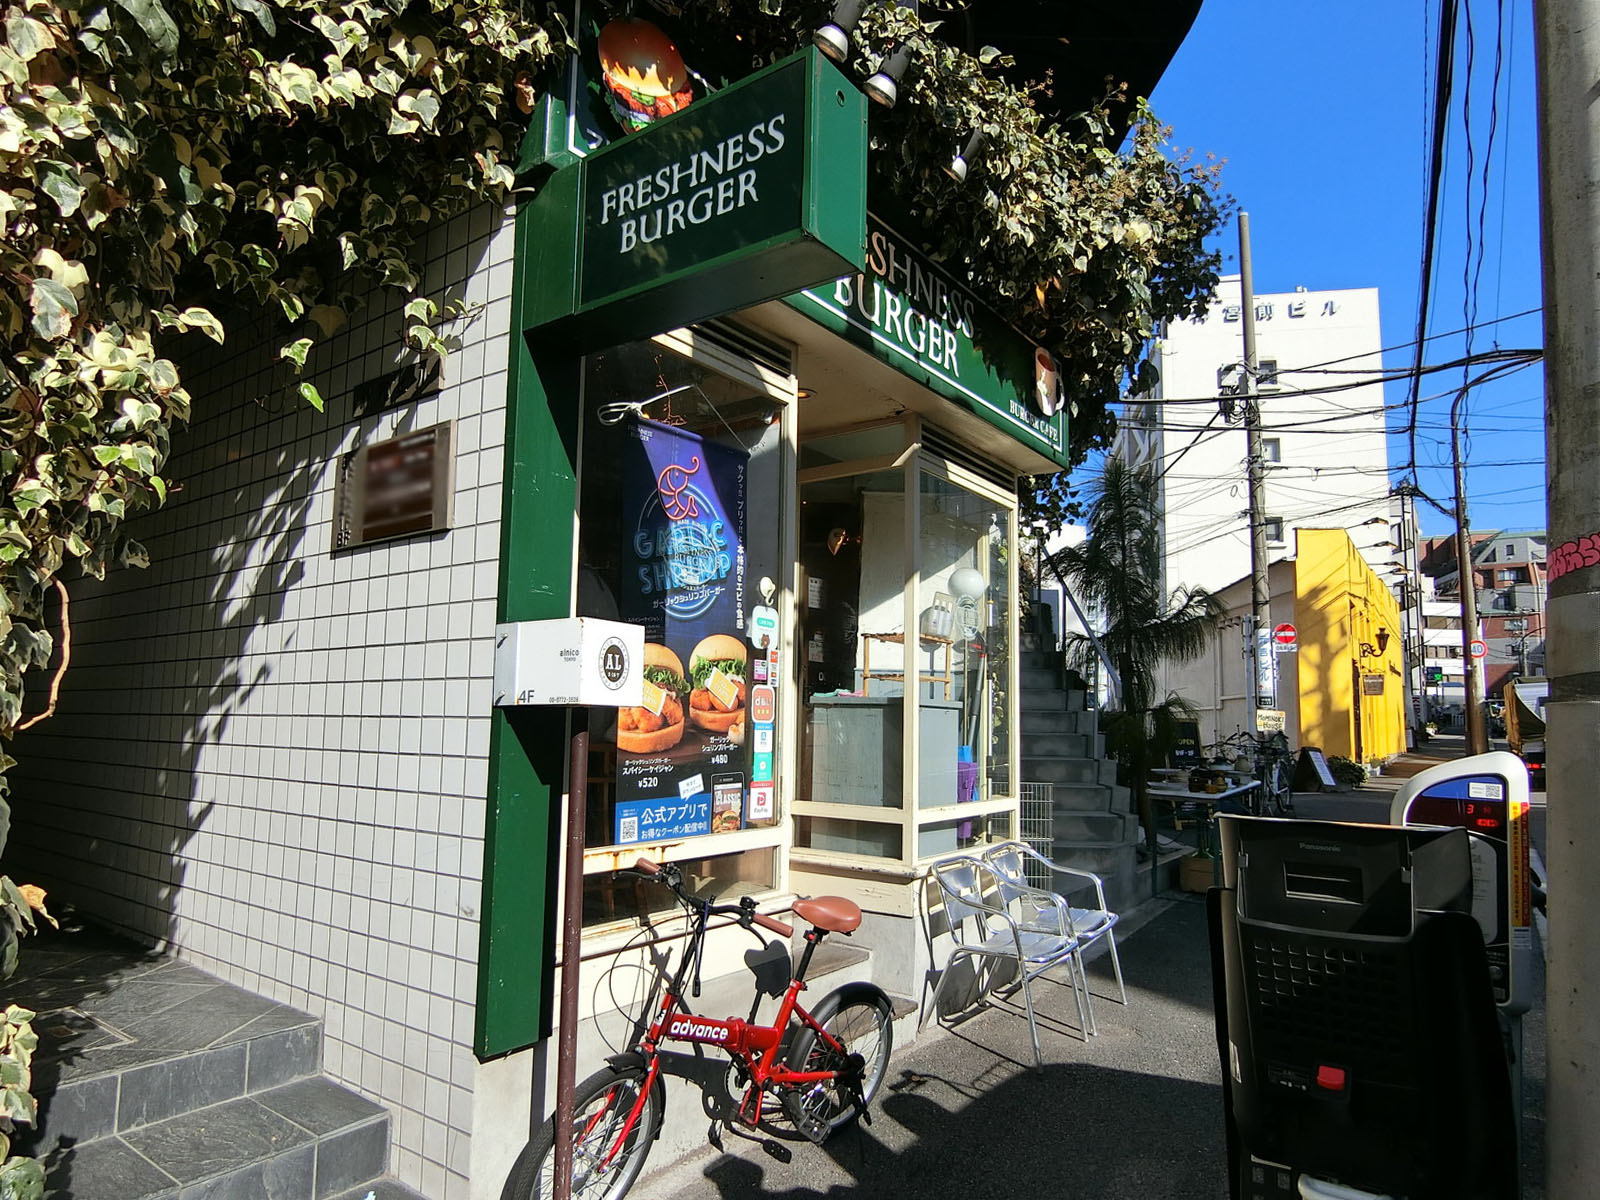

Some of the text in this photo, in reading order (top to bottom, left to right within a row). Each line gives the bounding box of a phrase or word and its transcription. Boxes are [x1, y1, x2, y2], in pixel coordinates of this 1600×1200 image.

[601, 114, 785, 224] FRESHNESS
[620, 169, 759, 254] BURGER
[866, 230, 974, 339] SHNESS
[834, 273, 960, 377] BURGER
[560, 648, 580, 657] alnico
[605, 653, 622, 670] AL
[518, 689, 535, 703] 4F
[711, 753, 729, 764] ¥480
[622, 765, 674, 775] スパイシーケイジャン
[638, 776, 659, 788] ¥520
[641, 803, 707, 825] 公式アプリで
[1299, 842, 1341, 852] Panasonic
[670, 1019, 729, 1040] advance
